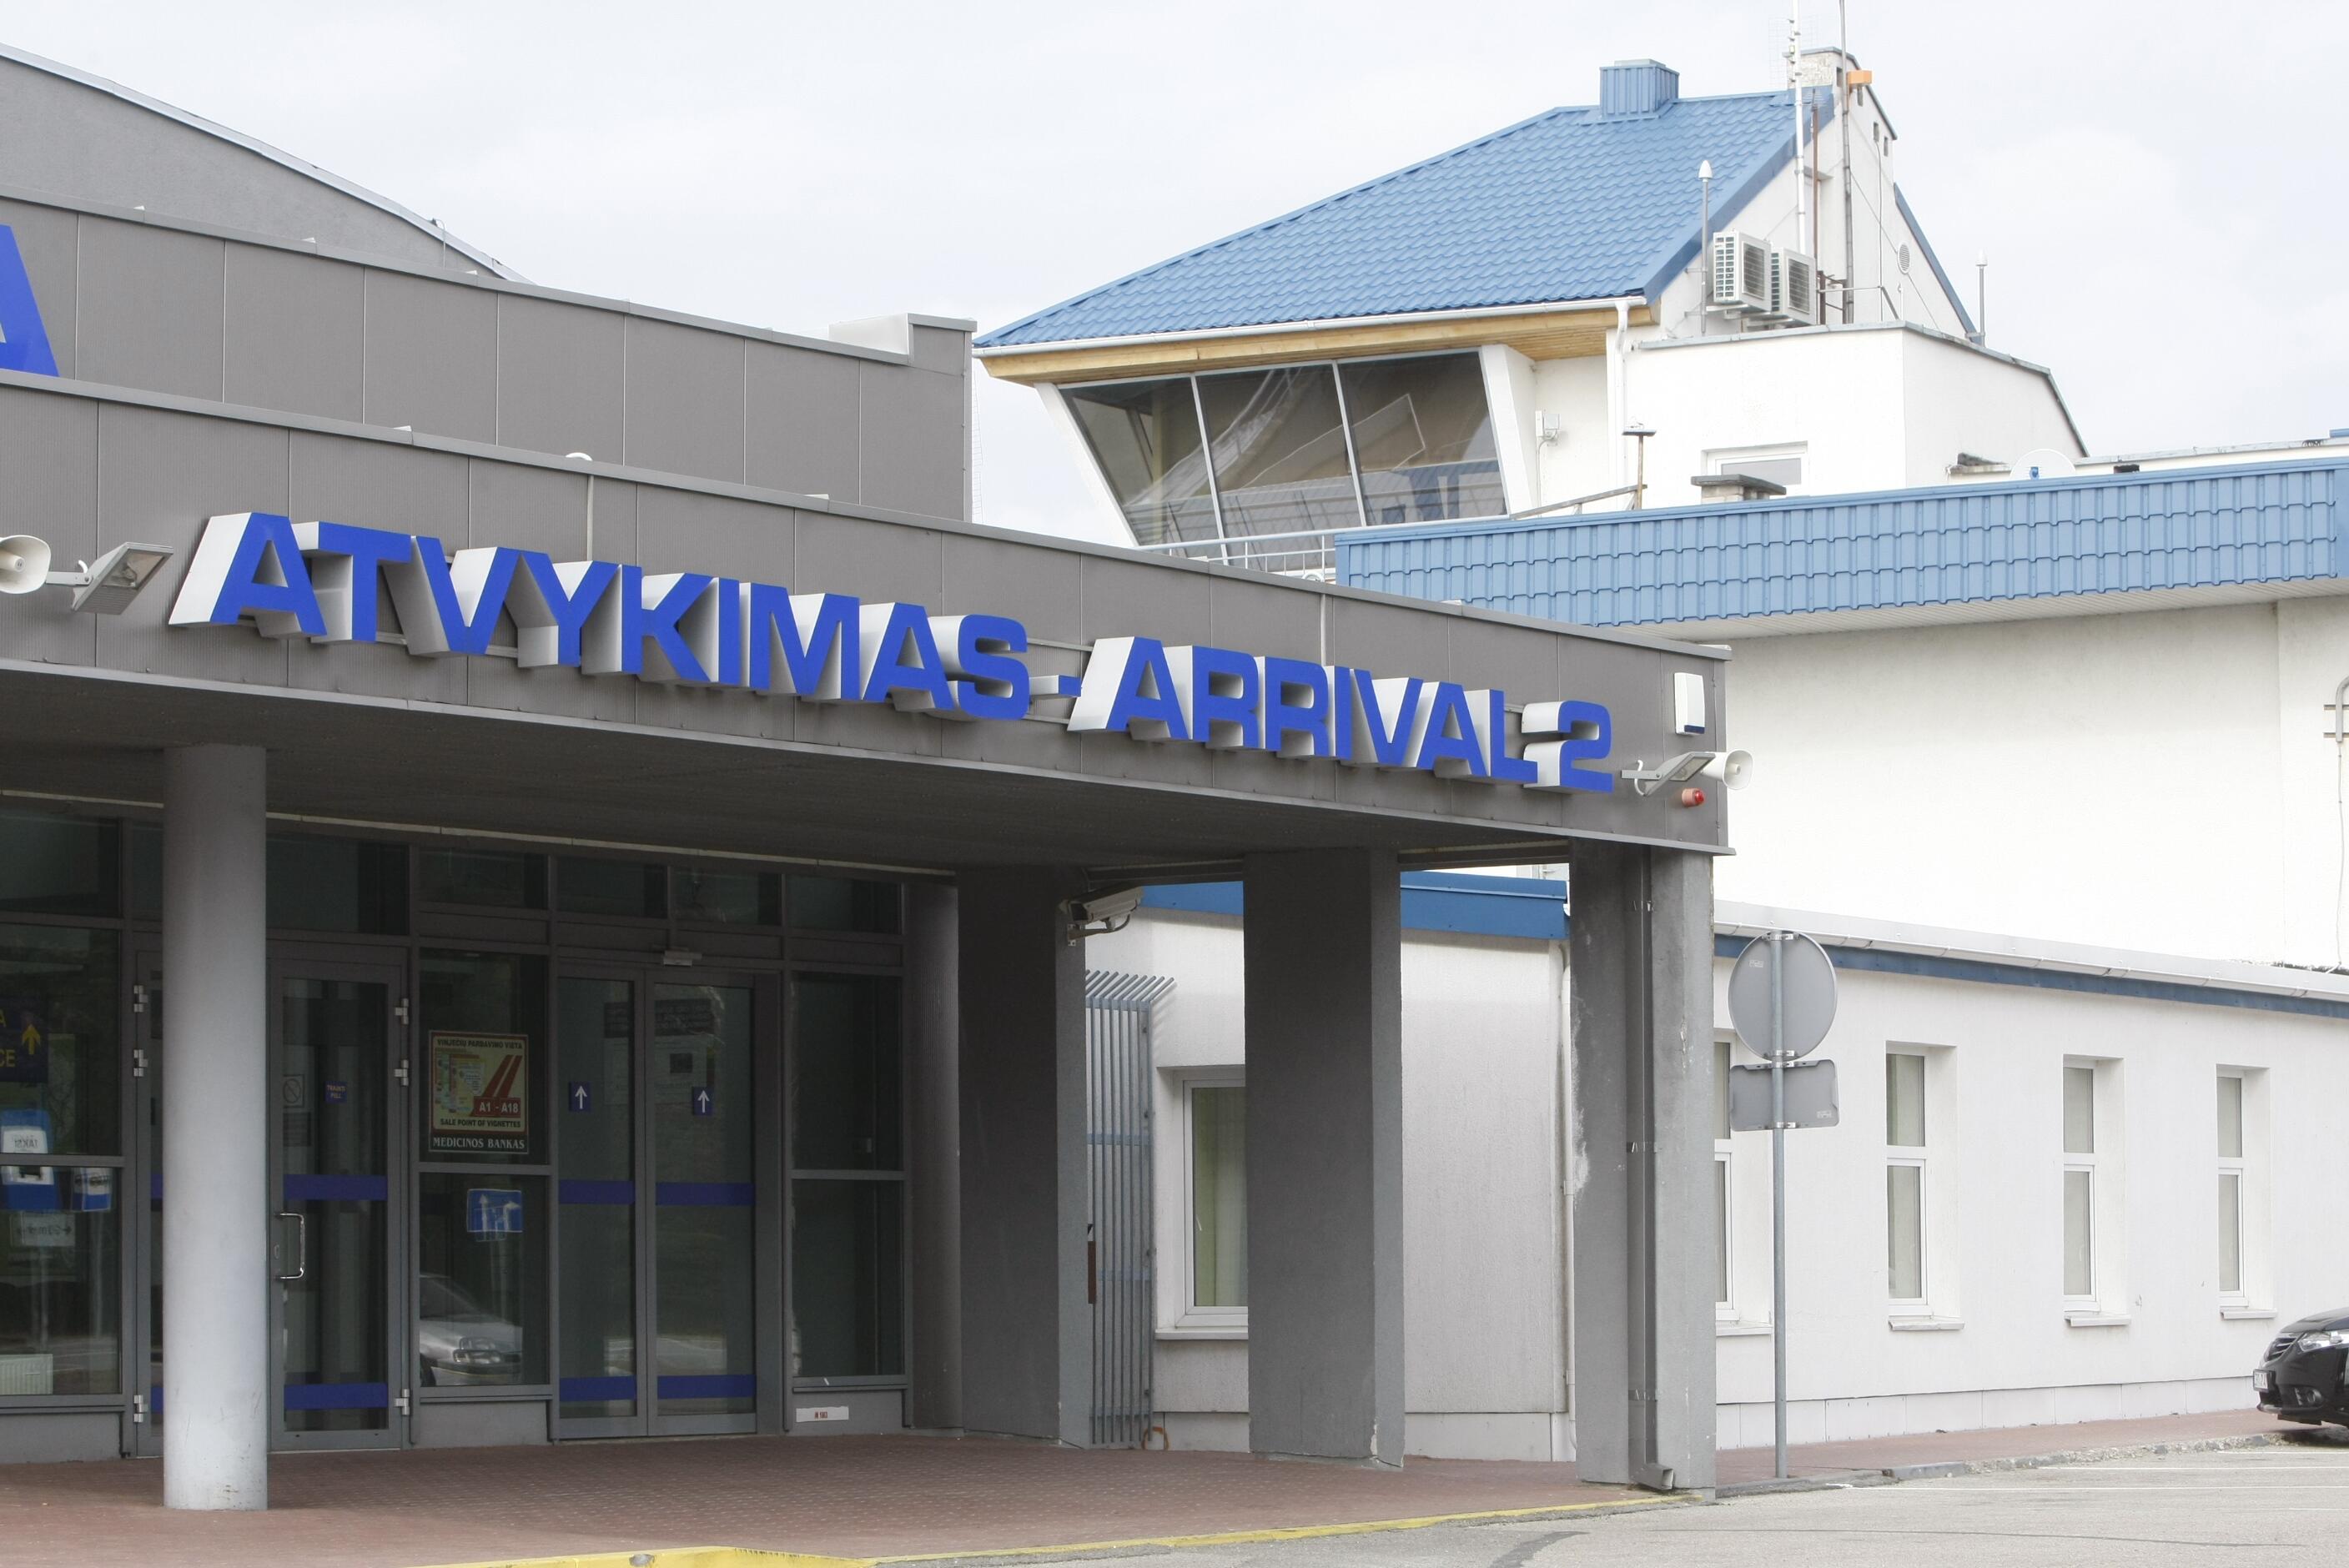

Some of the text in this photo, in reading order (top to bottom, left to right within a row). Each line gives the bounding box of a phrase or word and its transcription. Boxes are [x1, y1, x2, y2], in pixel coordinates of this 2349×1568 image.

[204, 512, 1030, 721] ATVYKIMAS
[1099, 636, 1537, 784] ARRIVAL
[1543, 700, 1613, 793] 2
[479, 1101, 490, 1113] A1
[501, 1102, 519, 1113] A18
[457, 1118, 476, 1127] POINT
[487, 1120, 521, 1128] VIGNETTES
[433, 1137, 525, 1149] MEDICINOS BANKAS
